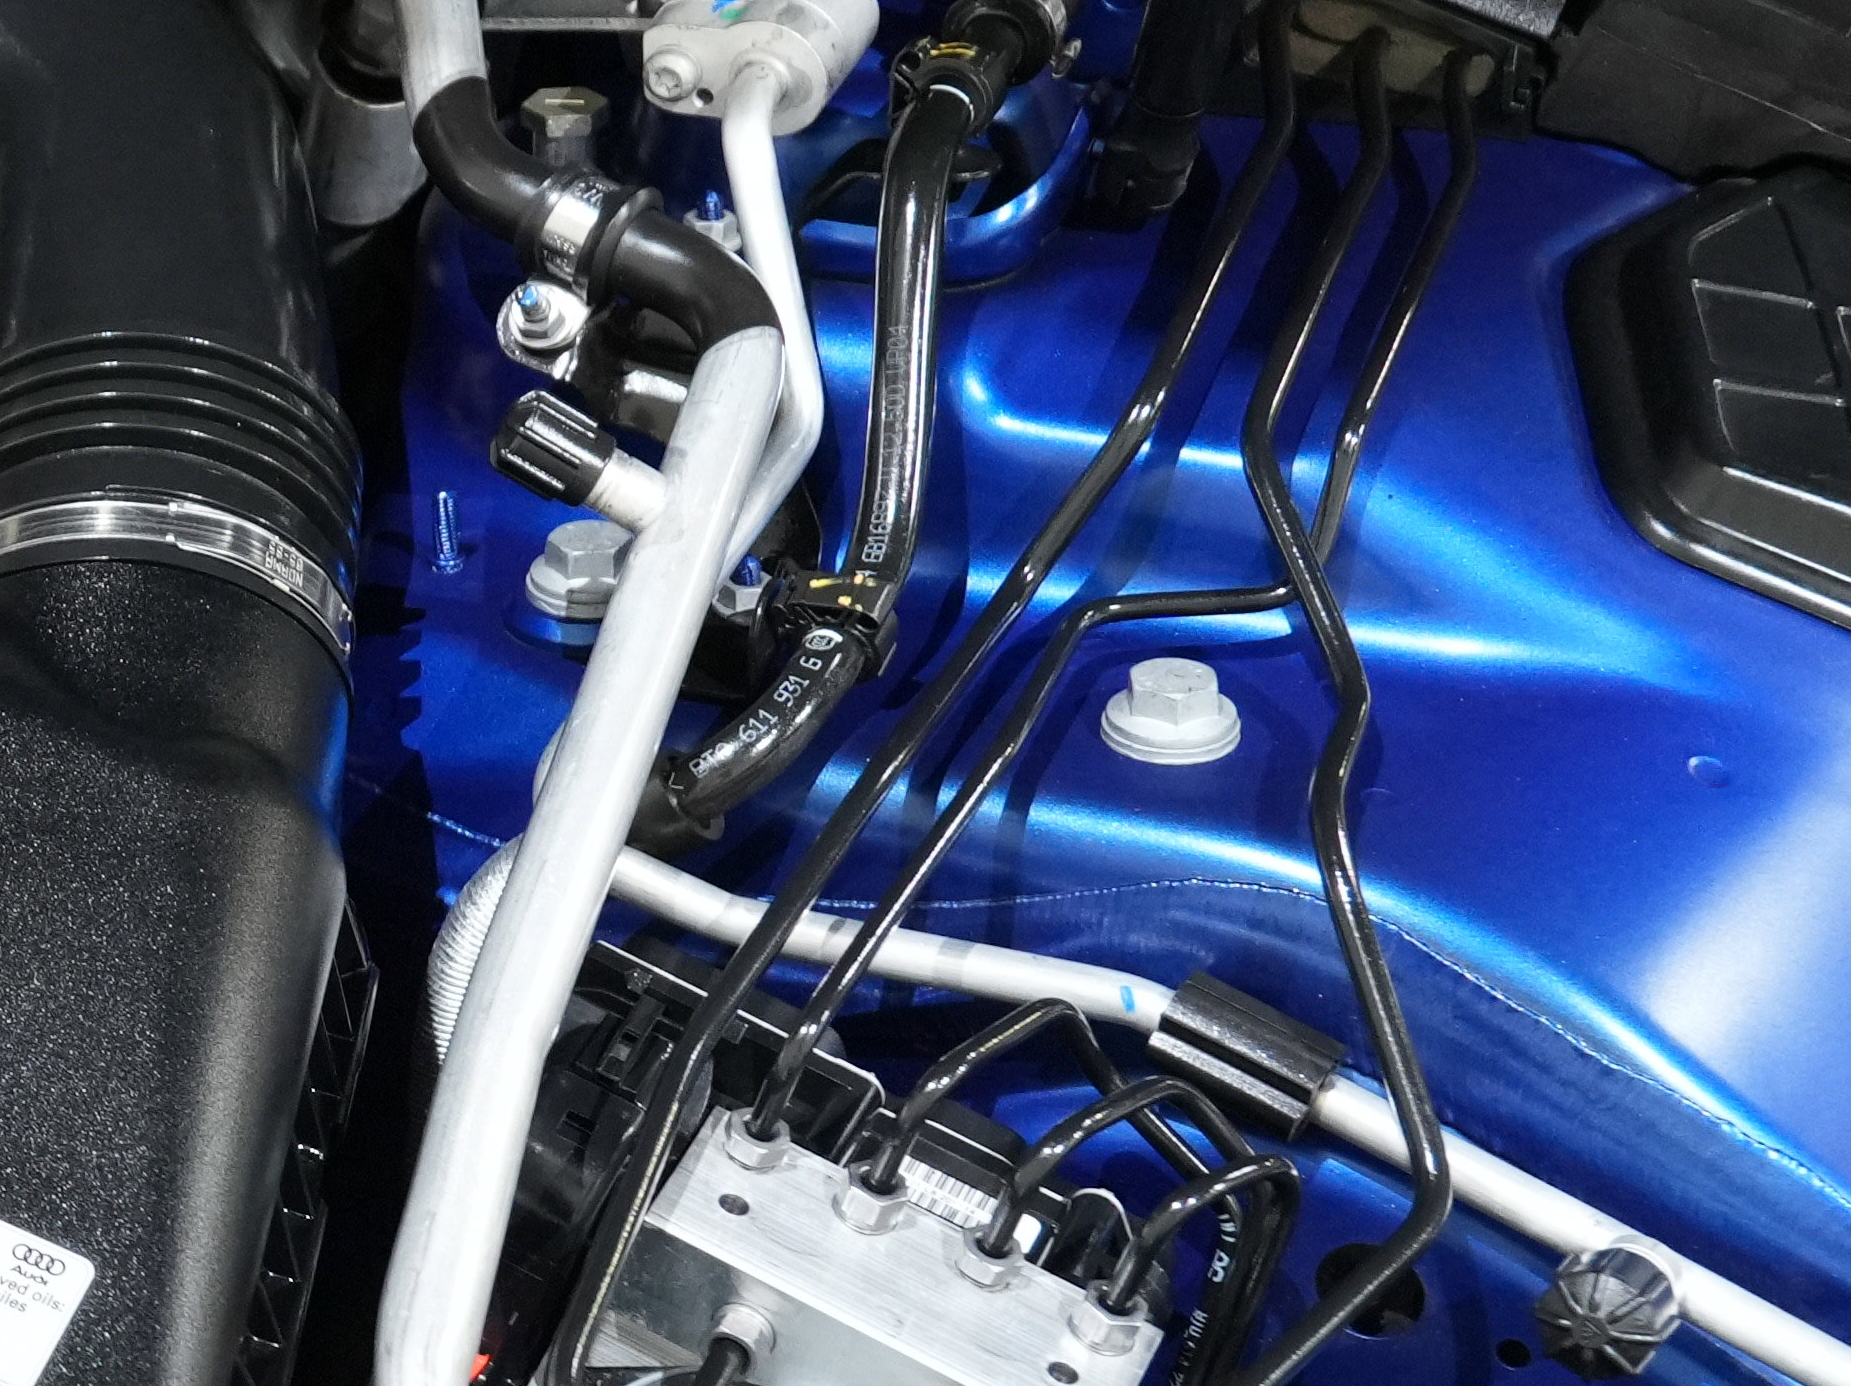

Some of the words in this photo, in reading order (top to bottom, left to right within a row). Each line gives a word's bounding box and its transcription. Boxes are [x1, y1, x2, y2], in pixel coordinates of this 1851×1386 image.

[265, 551, 303, 588] NORMA
[739, 708, 779, 743] 611
[774, 674, 810, 708] 931
[32, 1292, 64, 1312] oils:
